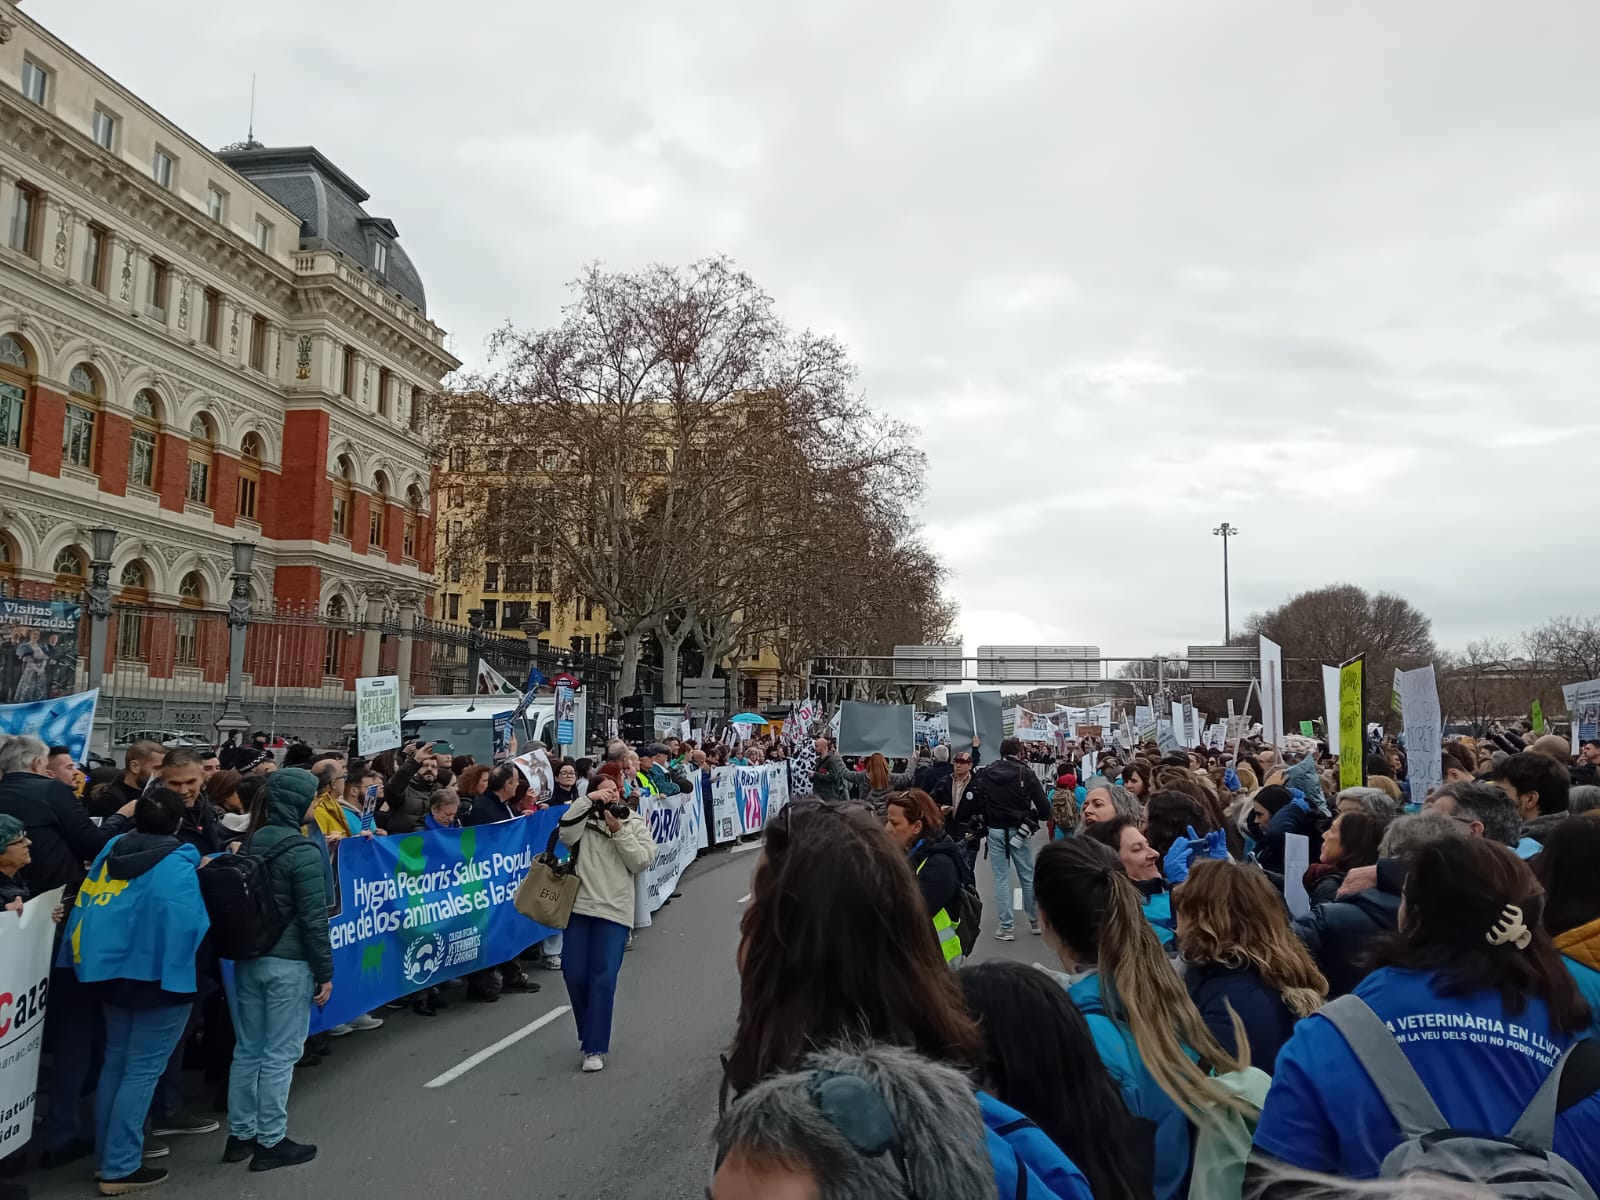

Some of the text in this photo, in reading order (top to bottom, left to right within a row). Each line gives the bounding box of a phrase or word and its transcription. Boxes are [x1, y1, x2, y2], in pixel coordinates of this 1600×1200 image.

[0, 614, 75, 629] tralizadas
[4, 601, 53, 617] Visitas
[741, 769, 760, 787] BASTA
[744, 786, 763, 831] YA
[354, 873, 396, 912] Hygia
[398, 864, 450, 898] Pecoris
[452, 857, 492, 887] Salus
[329, 873, 524, 950] ene de los animales es la sal
[1396, 1033, 1407, 1044] M
[1408, 1032, 1420, 1042] LA
[1420, 1031, 1440, 1041] VEU
[1443, 1031, 1467, 1041] DELS
[1470, 1033, 1487, 1044] QUI
[1489, 1036, 1504, 1047] NO
[1506, 1040, 1536, 1057] PODEN
[1397, 1012, 1505, 1034] VETERINÀRIA
[1509, 1023, 1529, 1042] EN
[1532, 1031, 1563, 1060] LLUIT
